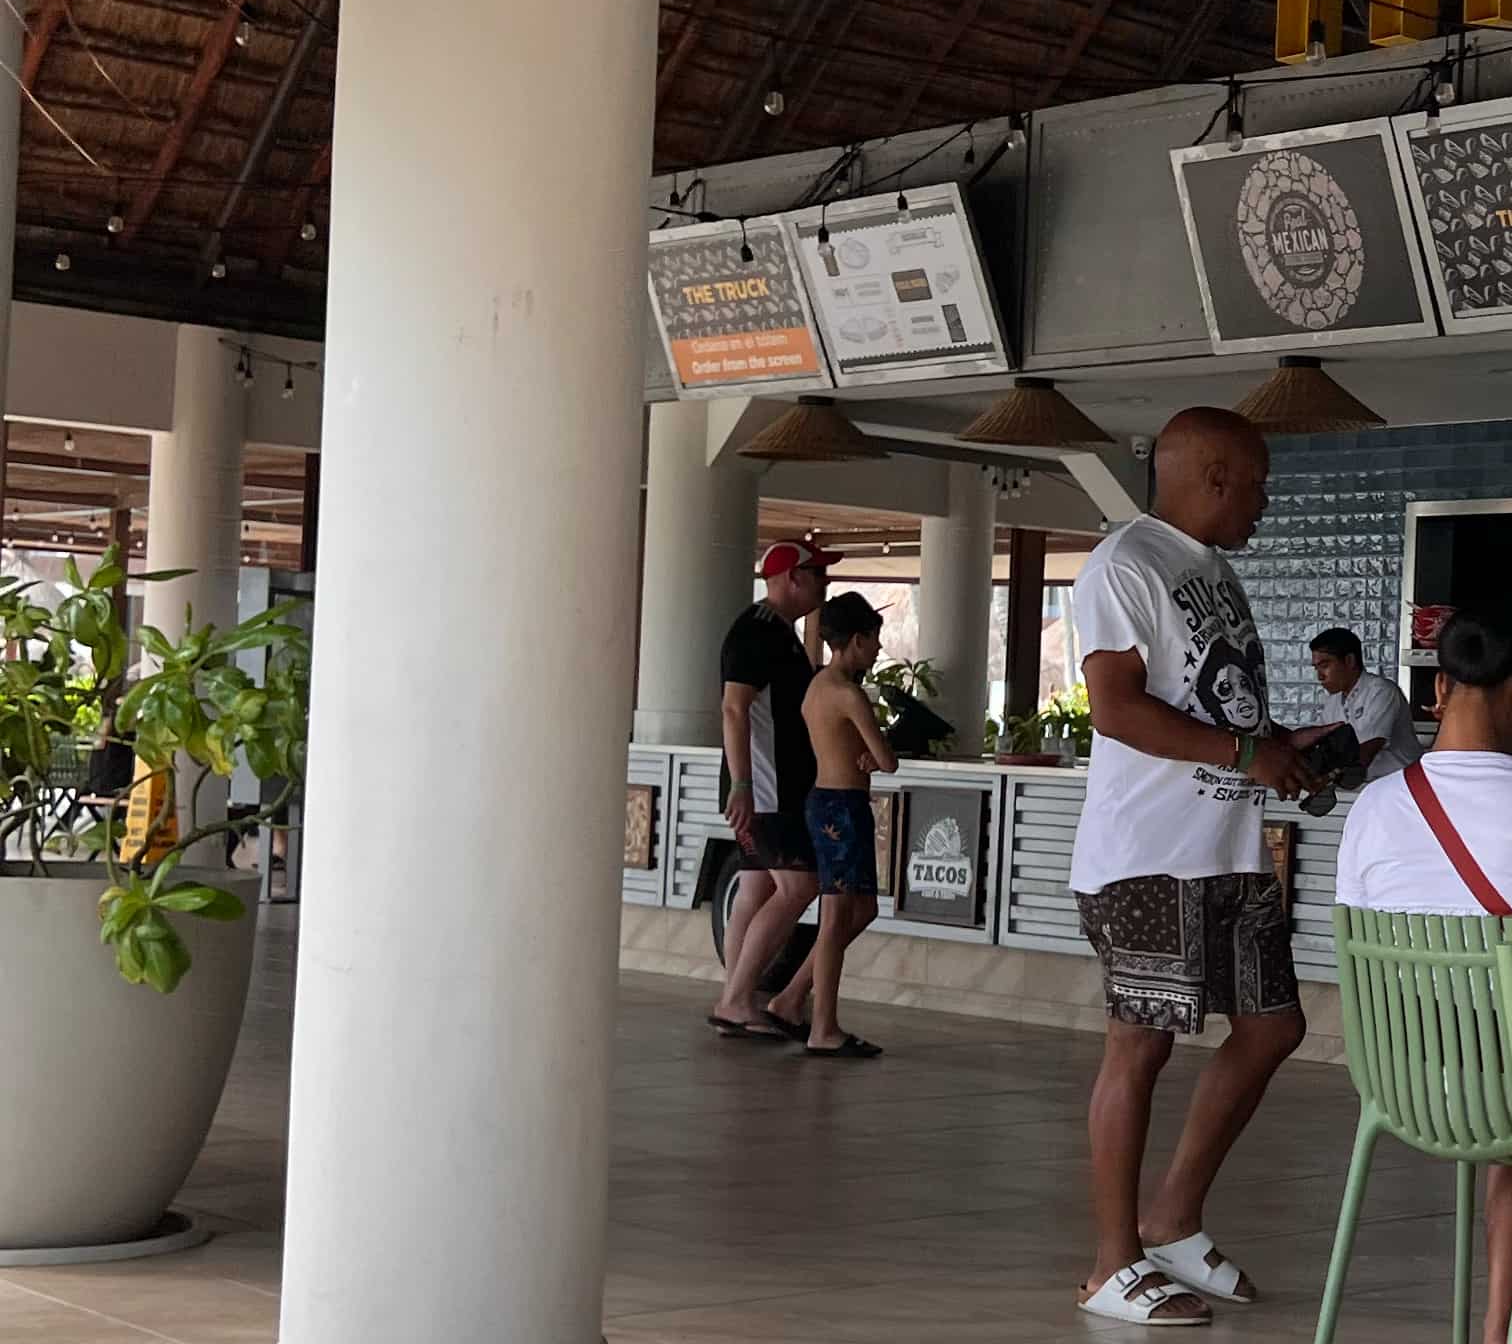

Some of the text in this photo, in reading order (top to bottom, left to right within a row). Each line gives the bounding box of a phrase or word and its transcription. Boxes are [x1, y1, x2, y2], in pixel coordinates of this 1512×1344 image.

[1271, 227, 1329, 254] MEXICAN
[682, 276, 770, 305] THE TRUCK
[913, 863, 967, 885] TACOS
